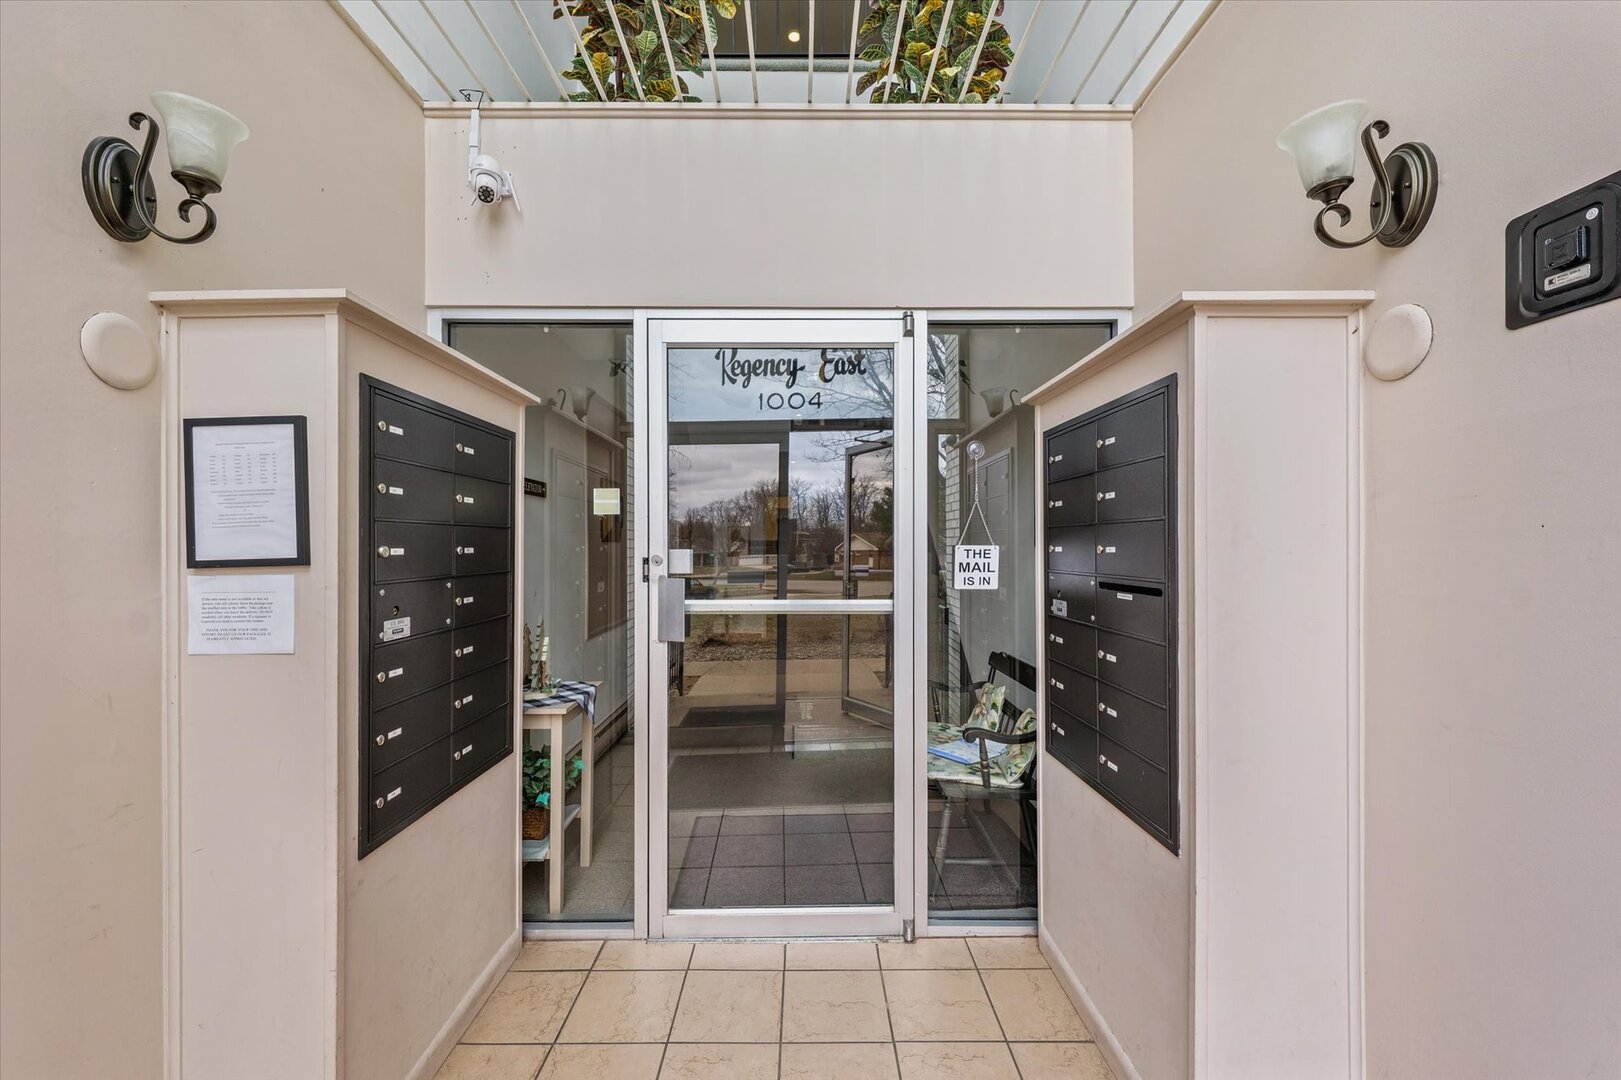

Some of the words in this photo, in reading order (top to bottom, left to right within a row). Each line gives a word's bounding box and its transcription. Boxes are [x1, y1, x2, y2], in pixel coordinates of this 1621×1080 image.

[714, 348, 806, 389] Regency
[818, 348, 867, 383] East
[758, 392, 823, 410] 1004
[964, 548, 991, 559] THE
[958, 562, 995, 573] MAIL
[963, 576, 975, 586] IS
[978, 576, 991, 586] IN
